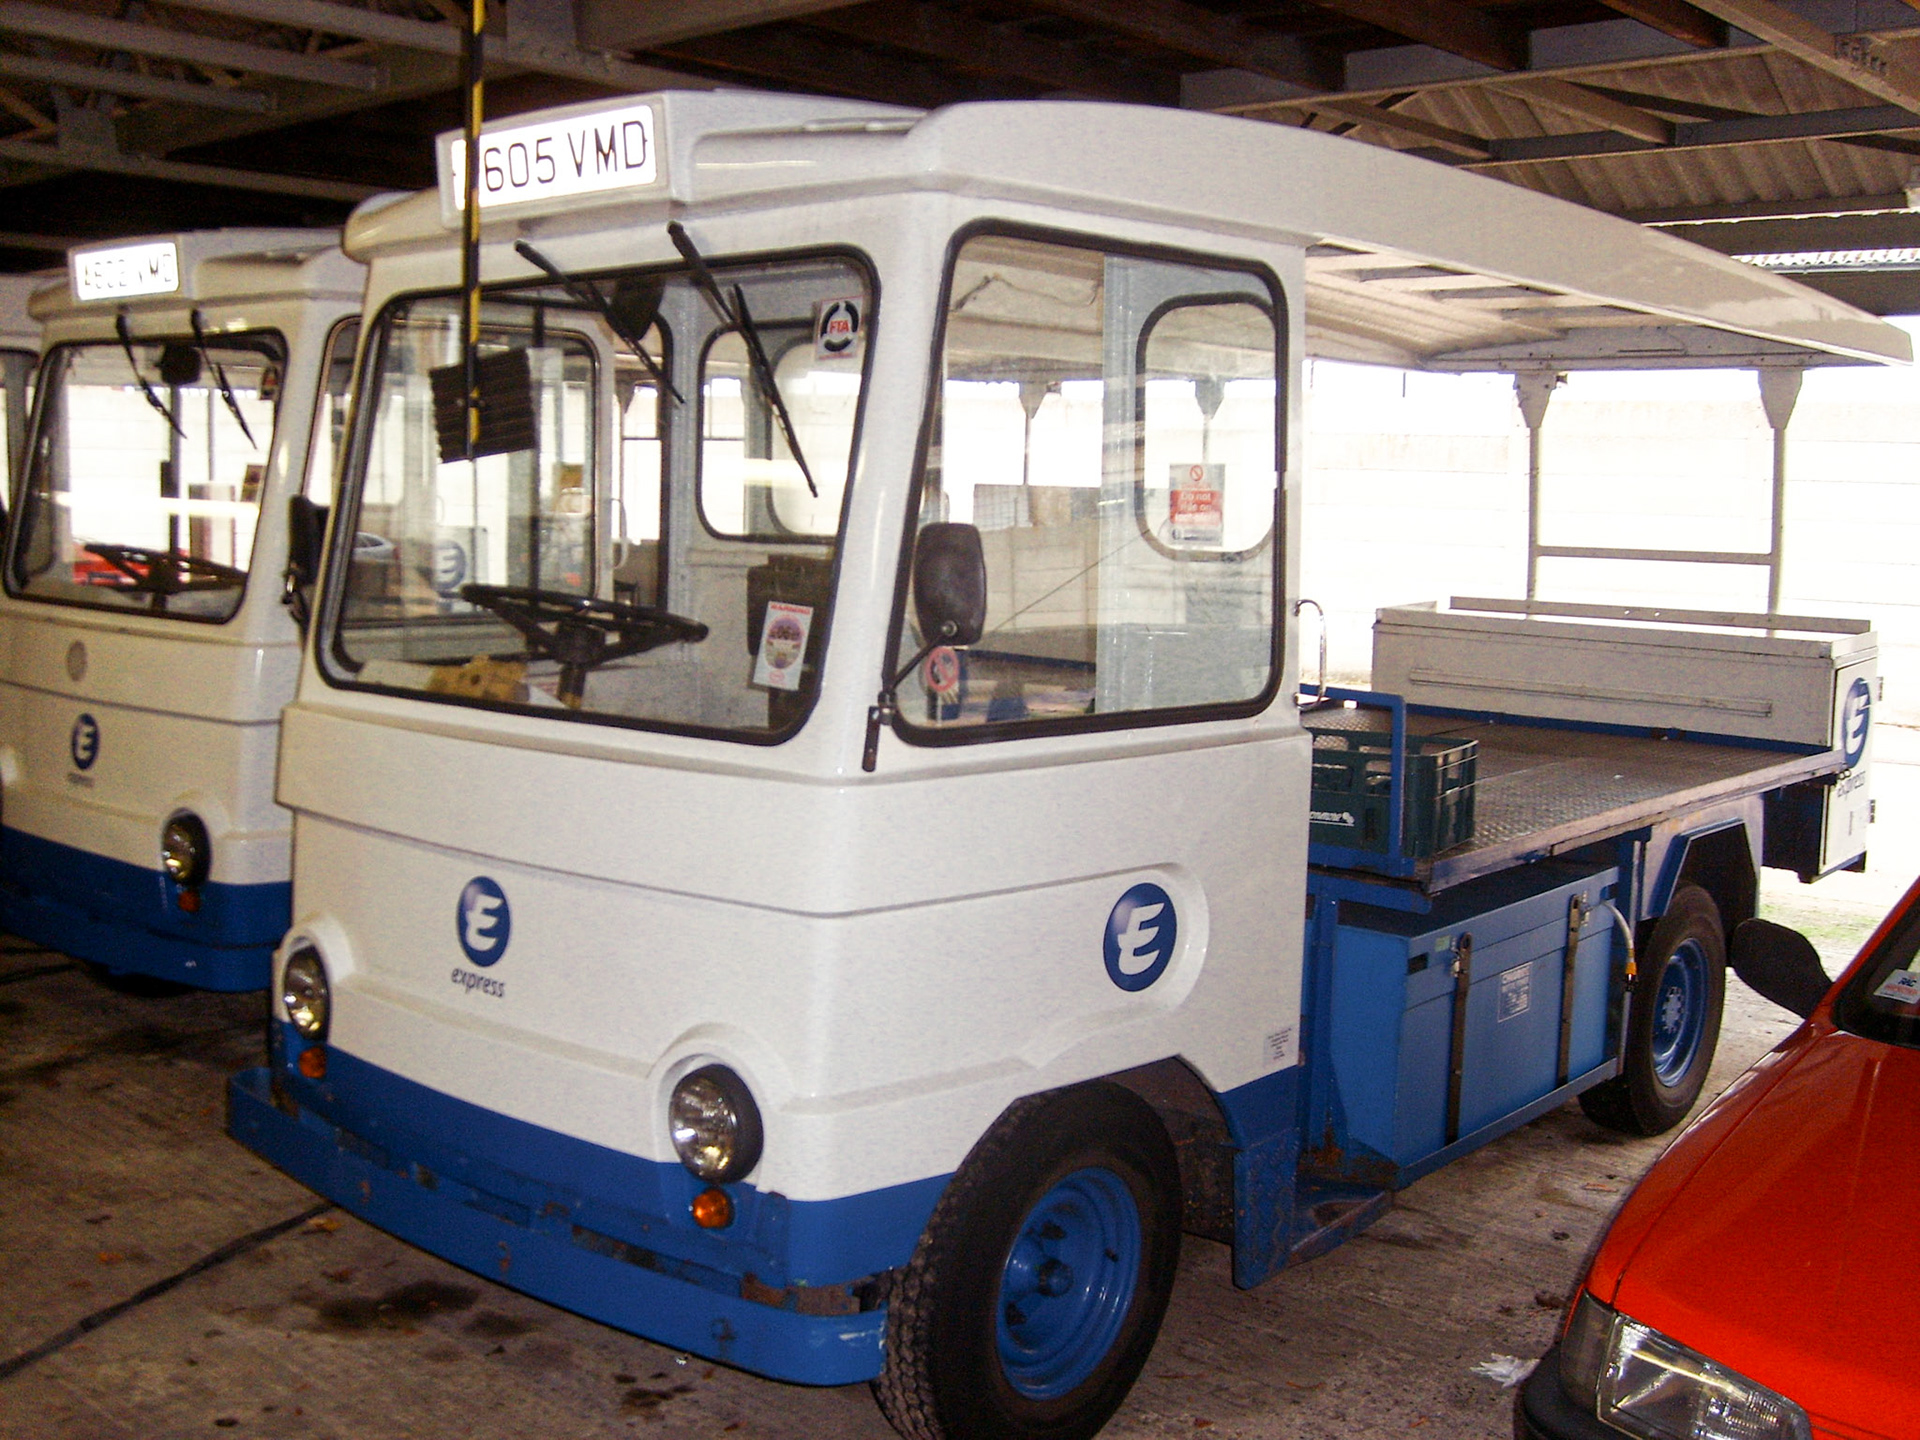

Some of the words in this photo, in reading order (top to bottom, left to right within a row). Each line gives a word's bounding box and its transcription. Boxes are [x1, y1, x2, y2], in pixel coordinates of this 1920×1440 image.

[567, 120, 648, 178] VMD
[829, 319, 850, 335] FTA
[451, 968, 505, 998] express
